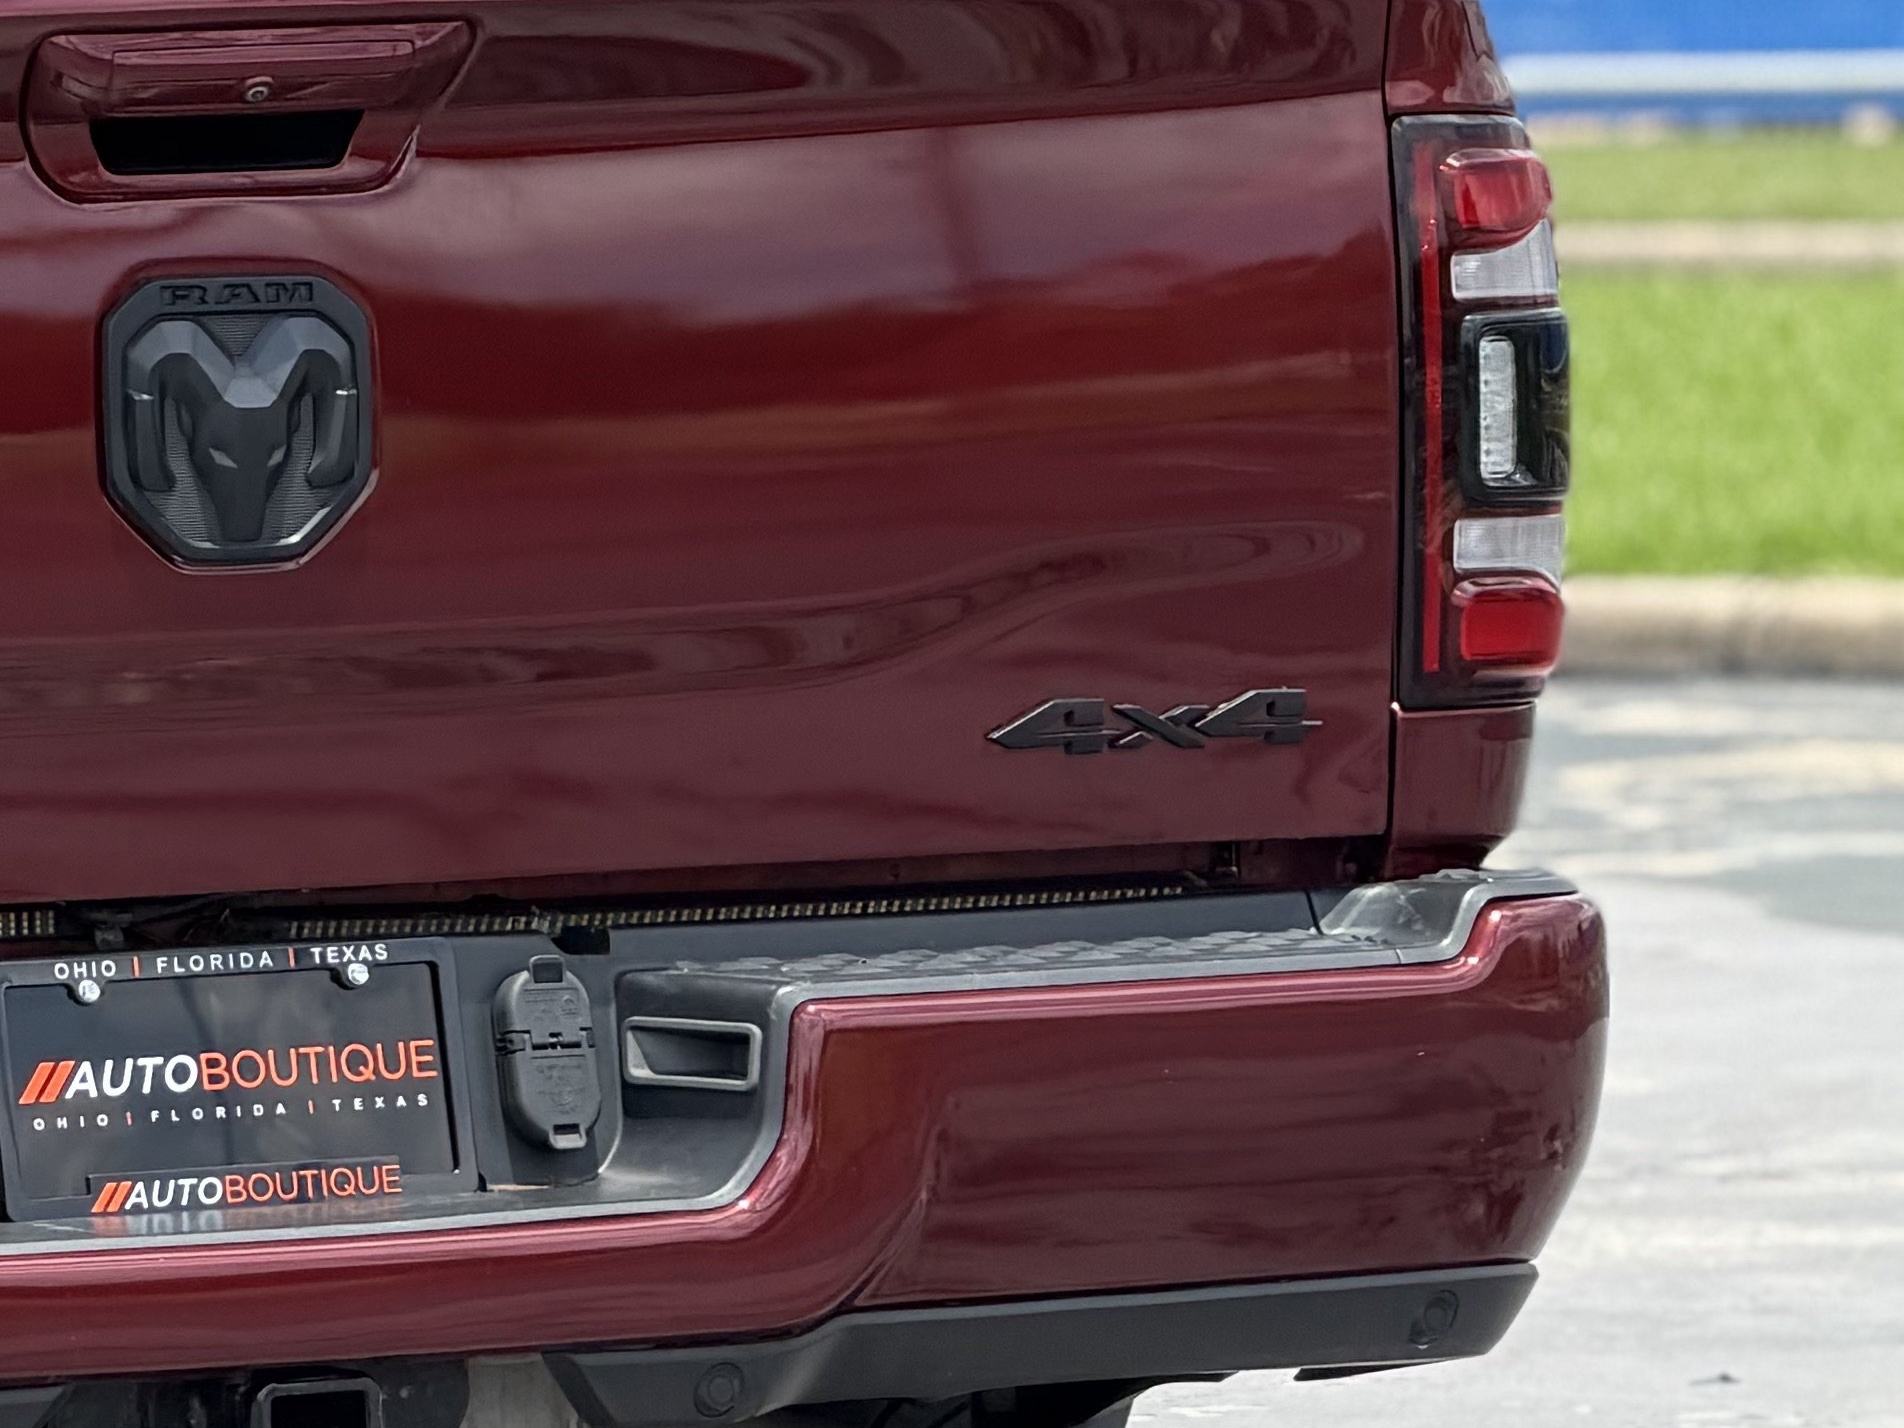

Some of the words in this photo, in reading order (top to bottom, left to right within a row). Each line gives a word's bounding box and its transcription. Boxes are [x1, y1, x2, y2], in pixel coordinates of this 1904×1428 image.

[160, 282, 314, 307] RAM
[53, 959, 117, 980] OHIO
[155, 950, 275, 975] FLORIDA
[309, 943, 388, 964] TEXAS
[64, 1039, 439, 1100] AUTOBOUTIQUE
[32, 1112, 109, 1132] OHIO
[150, 1101, 287, 1123] FLORIDA
[331, 1093, 429, 1113] TEXAS
[124, 1164, 403, 1211] AUTOBOUTIQUE
